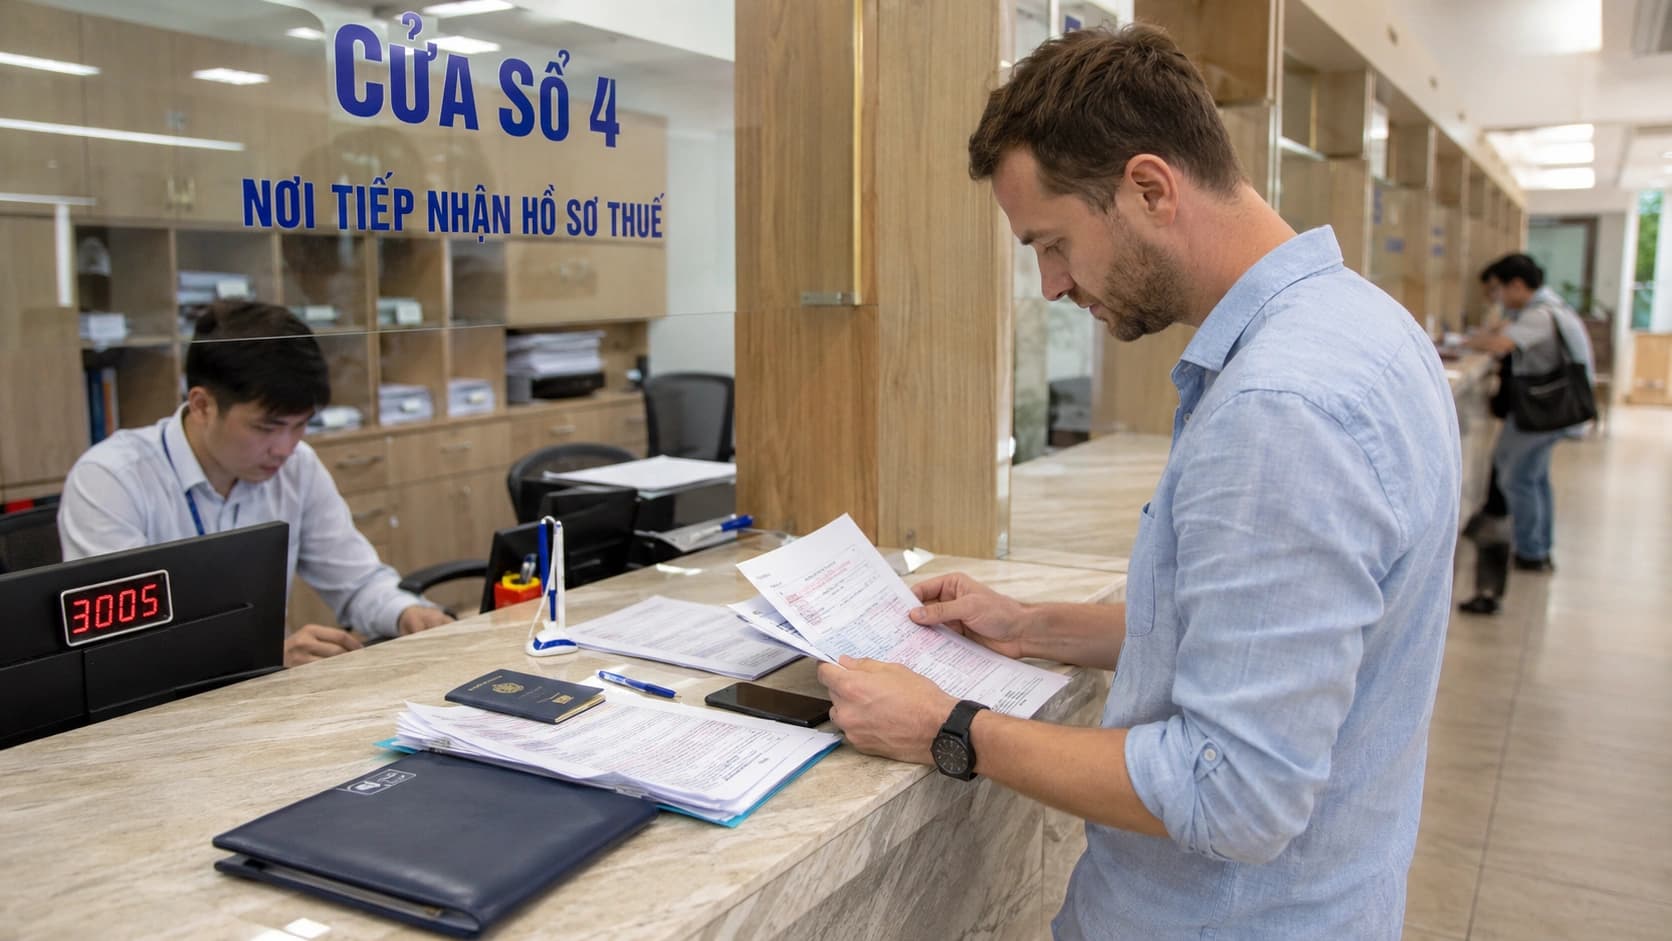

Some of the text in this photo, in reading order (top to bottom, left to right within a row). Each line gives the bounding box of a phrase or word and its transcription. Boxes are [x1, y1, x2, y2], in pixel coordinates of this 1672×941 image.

[334, 11, 620, 148] CỬA SỔ 4
[242, 171, 664, 243] NƠI TIẾP NHẬN HỒ SƠ THUẾ
[72, 583, 158, 634] 3005
